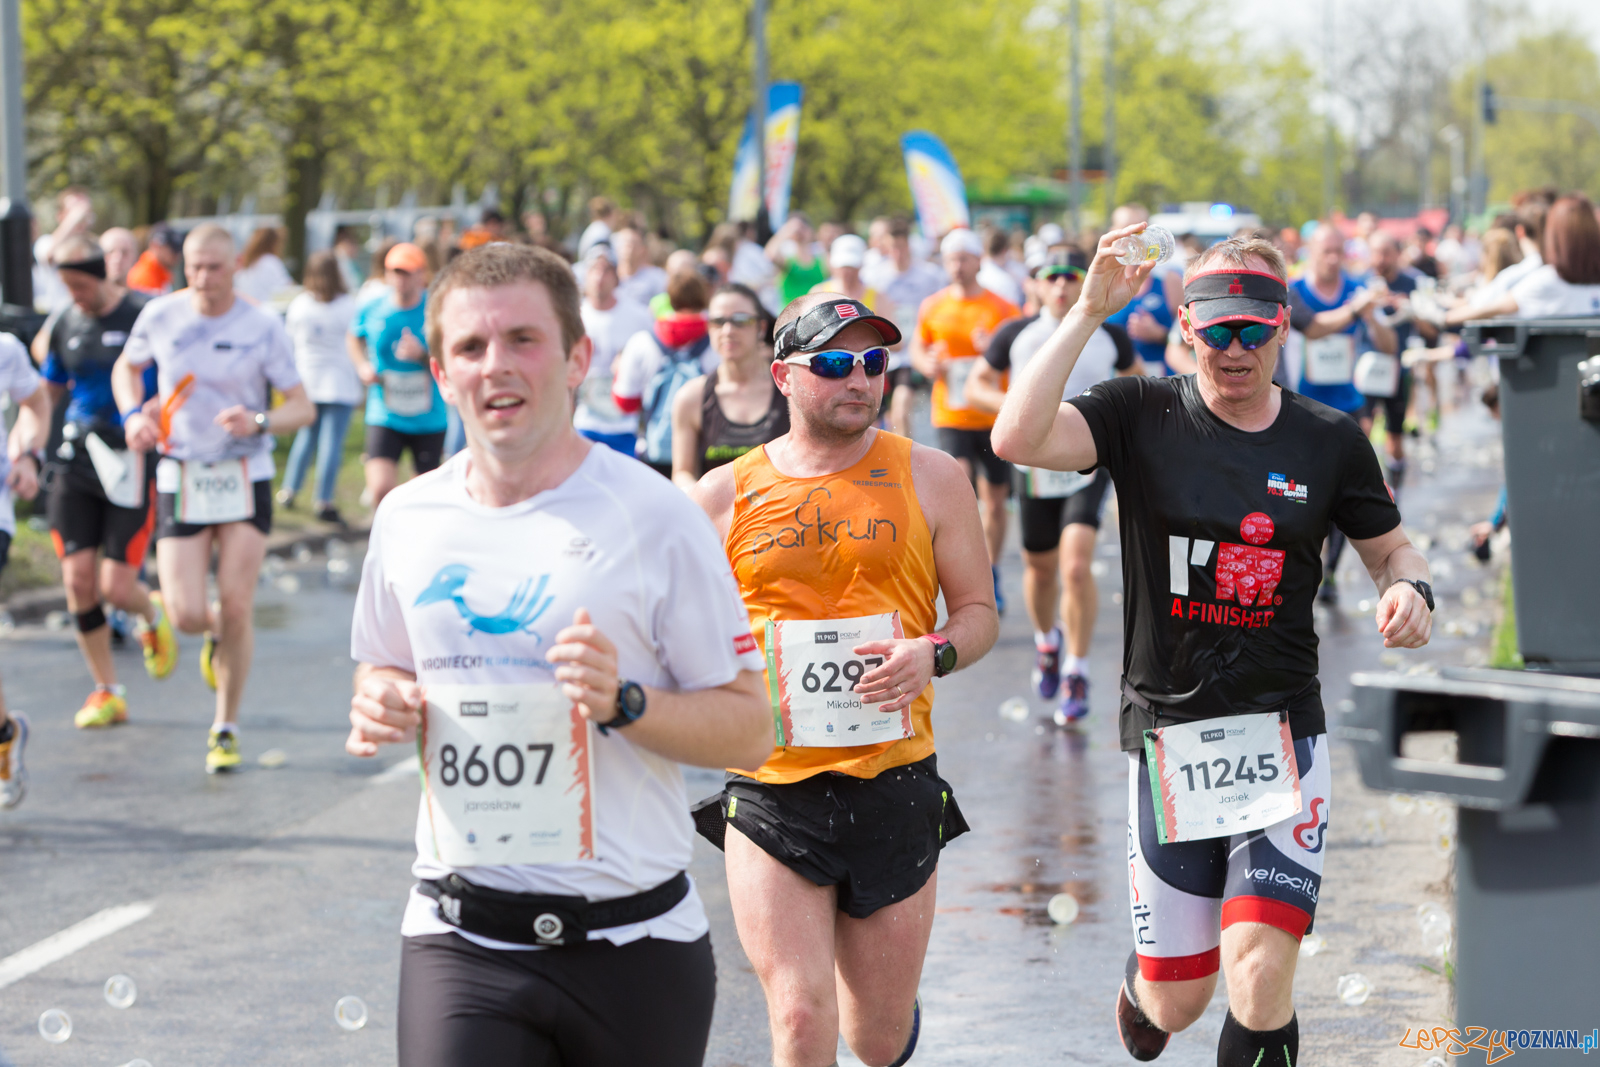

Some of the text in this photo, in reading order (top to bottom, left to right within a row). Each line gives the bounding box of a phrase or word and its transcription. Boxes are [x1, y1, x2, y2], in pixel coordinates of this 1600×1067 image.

[852, 480, 902, 489] TRIBESPORTS
[1267, 487, 1284, 497] 70.3
[1268, 479, 1308, 493] IRONMAN
[752, 490, 897, 565] parkrun
[1170, 598, 1275, 629] A FINISHER
[826, 700, 863, 710] Mikołaj
[440, 743, 554, 787] 8607
[1179, 753, 1279, 791] 11245
[1218, 792, 1250, 804] Jasiek
[1244, 867, 1319, 903] velocity
